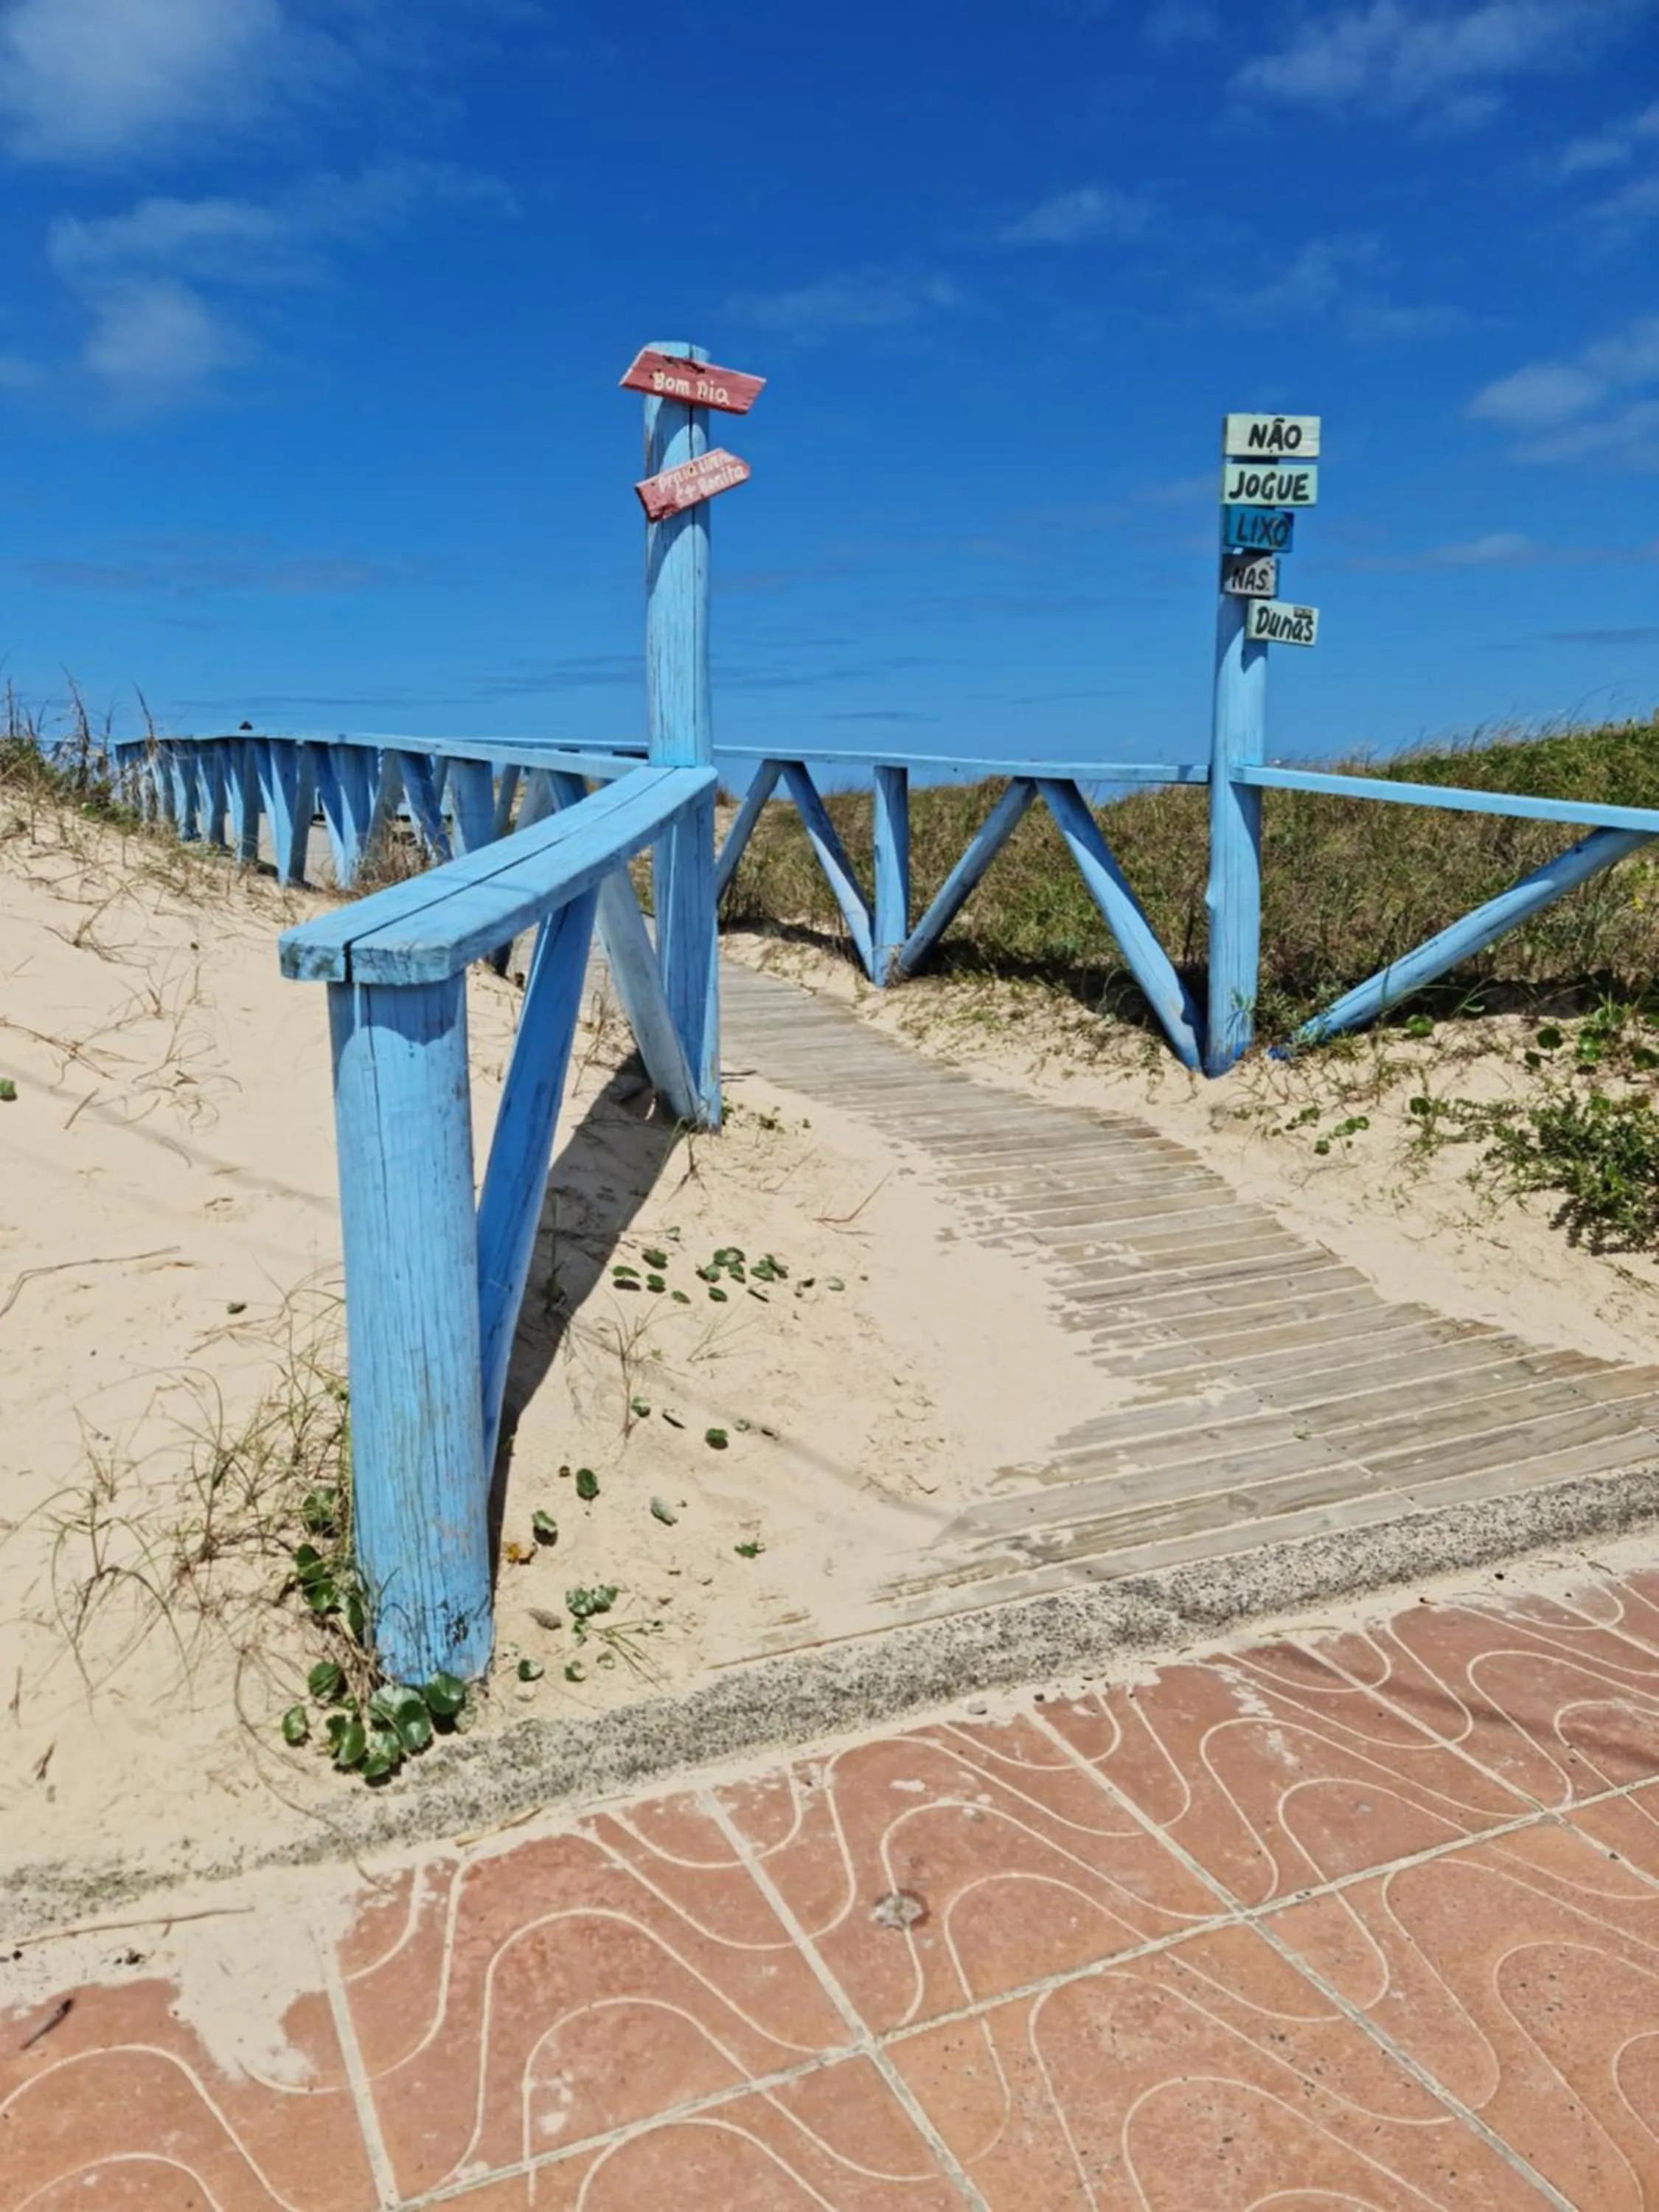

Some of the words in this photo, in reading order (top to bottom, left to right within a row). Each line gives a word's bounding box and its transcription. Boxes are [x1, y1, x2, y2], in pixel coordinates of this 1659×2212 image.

[653, 371, 690, 396] Bom
[696, 380, 730, 406] Dia
[1248, 418, 1302, 451] NÃO
[1228, 471, 1310, 501] JOGUE
[1236, 513, 1290, 547] LIXO
[1232, 567, 1268, 591] NAS
[1255, 606, 1313, 641] Dunas
